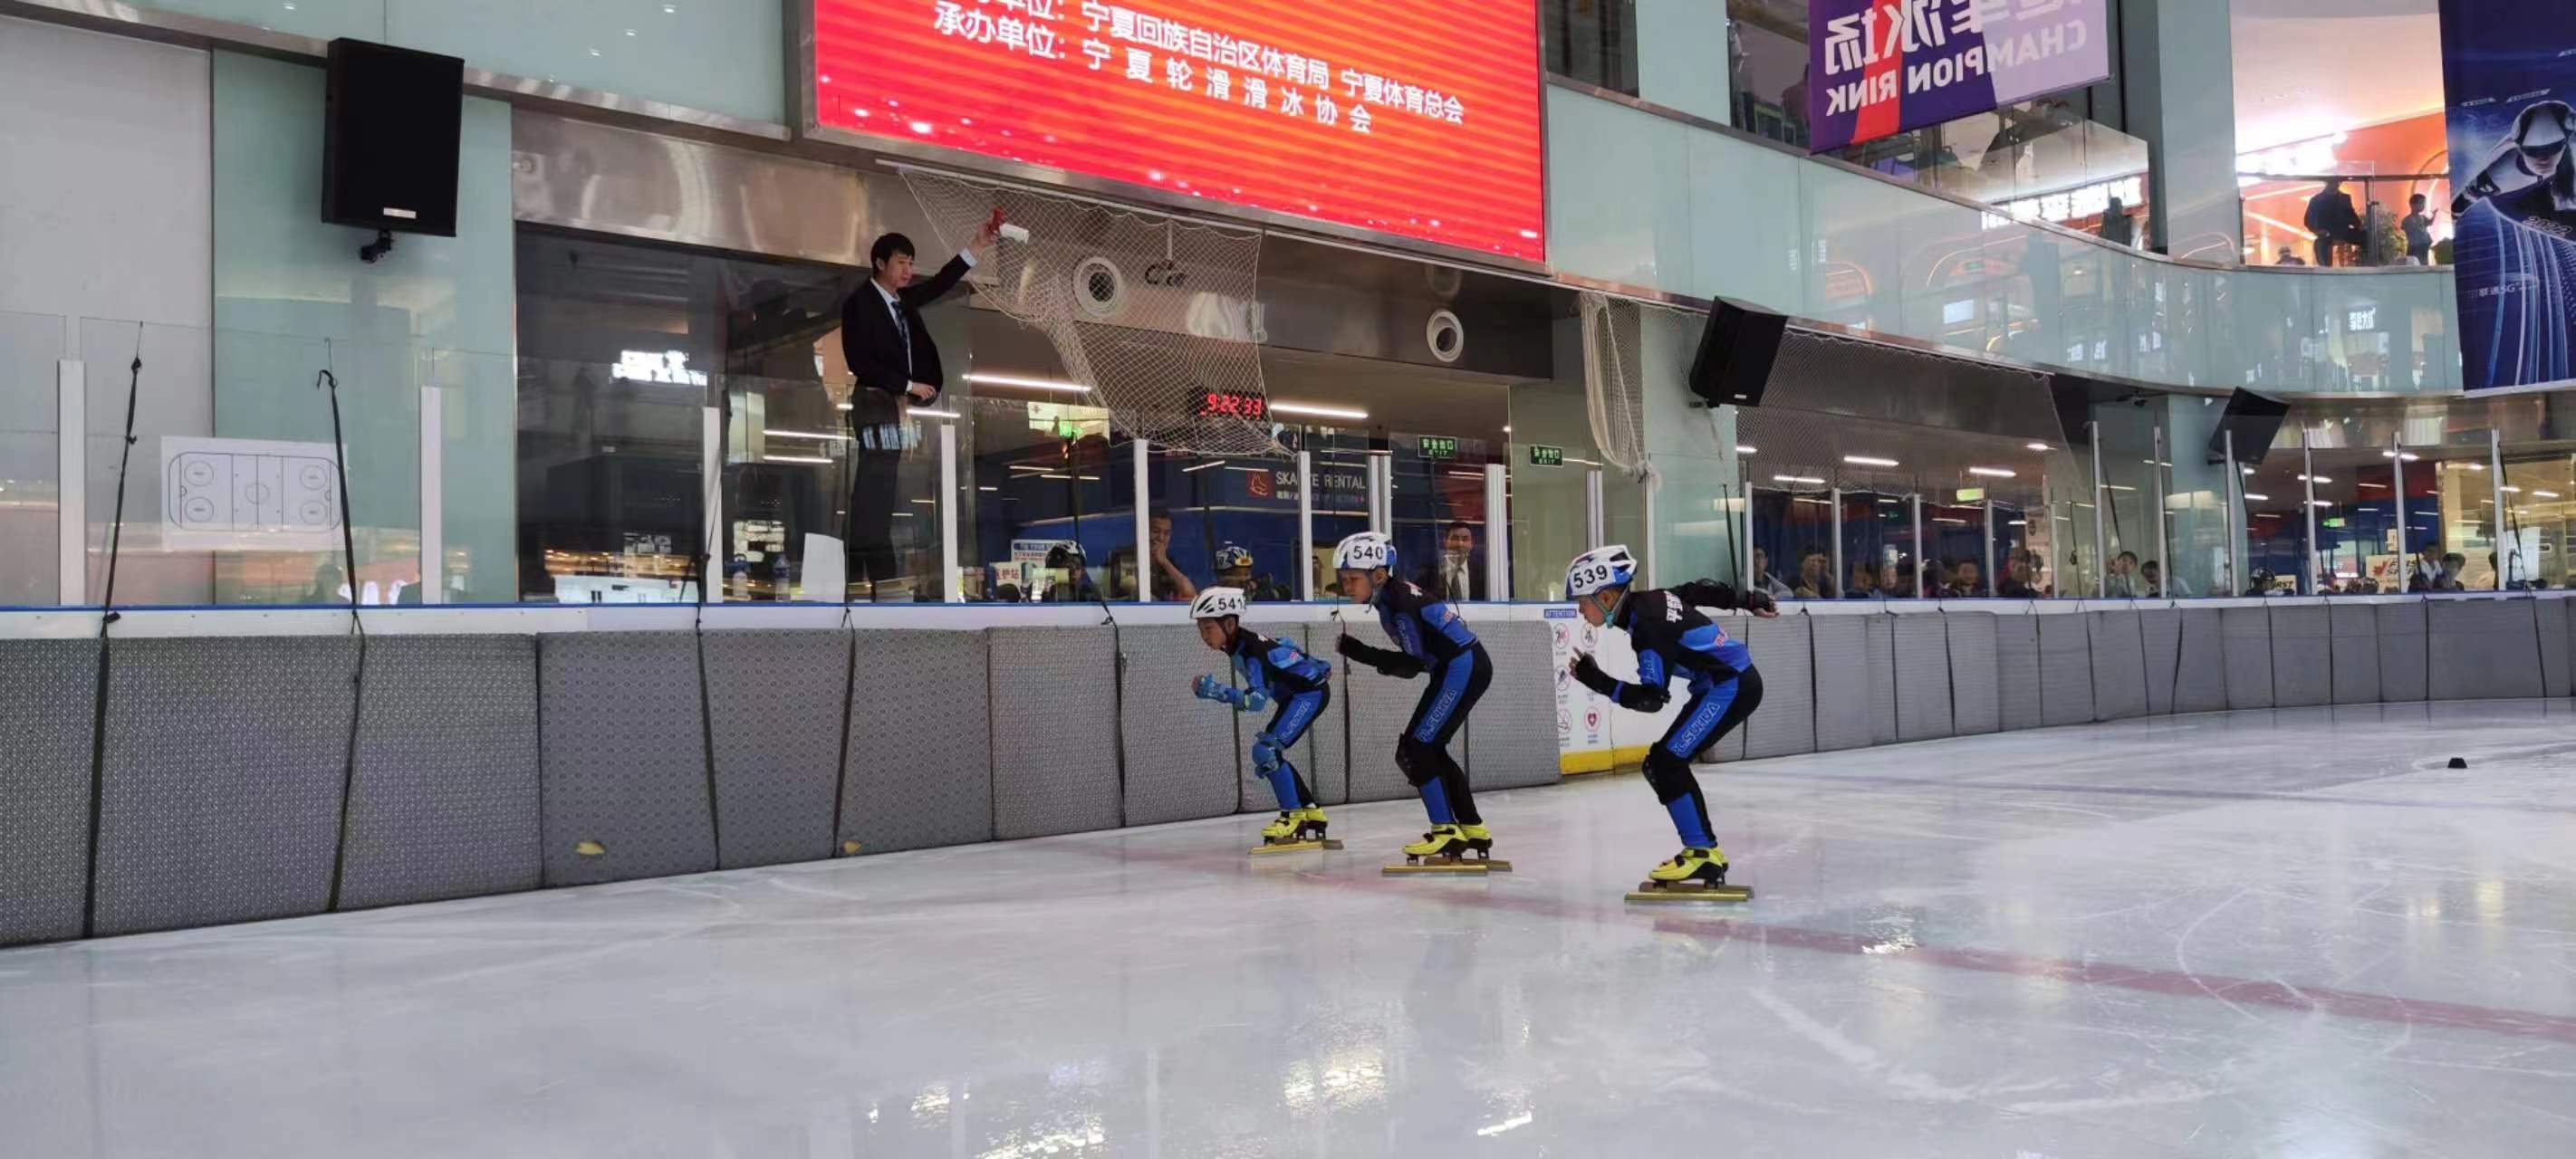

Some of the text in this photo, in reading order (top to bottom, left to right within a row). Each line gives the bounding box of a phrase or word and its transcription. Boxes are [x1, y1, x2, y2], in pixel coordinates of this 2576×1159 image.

[1081, 0, 1330, 90] 宁夏回族自治区体育局
[1341, 67, 1464, 125] 宁夏体育总会
[1275, 471, 1366, 489] SKAE RENTAL
[1353, 545, 1383, 560] 540
[1572, 564, 1609, 589] 539
[1217, 598, 1243, 611] 541
